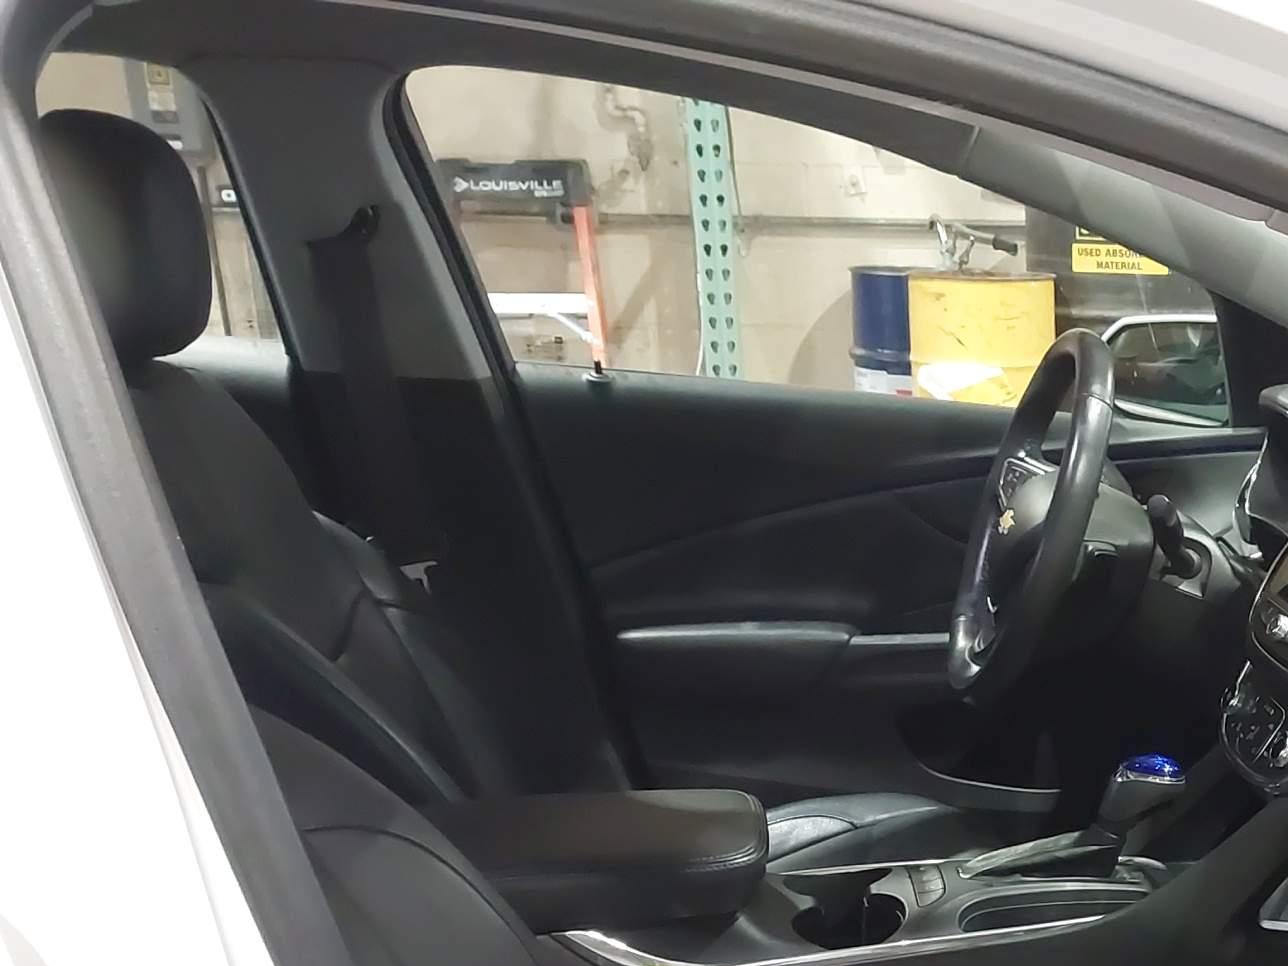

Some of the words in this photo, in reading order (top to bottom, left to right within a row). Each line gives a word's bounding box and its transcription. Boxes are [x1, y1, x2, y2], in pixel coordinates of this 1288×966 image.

[469, 179, 563, 191] LOUISVILLE
[1077, 247, 1102, 257] USED
[1104, 248, 1138, 258] ABSO
[1096, 260, 1143, 271] MATERIAL
